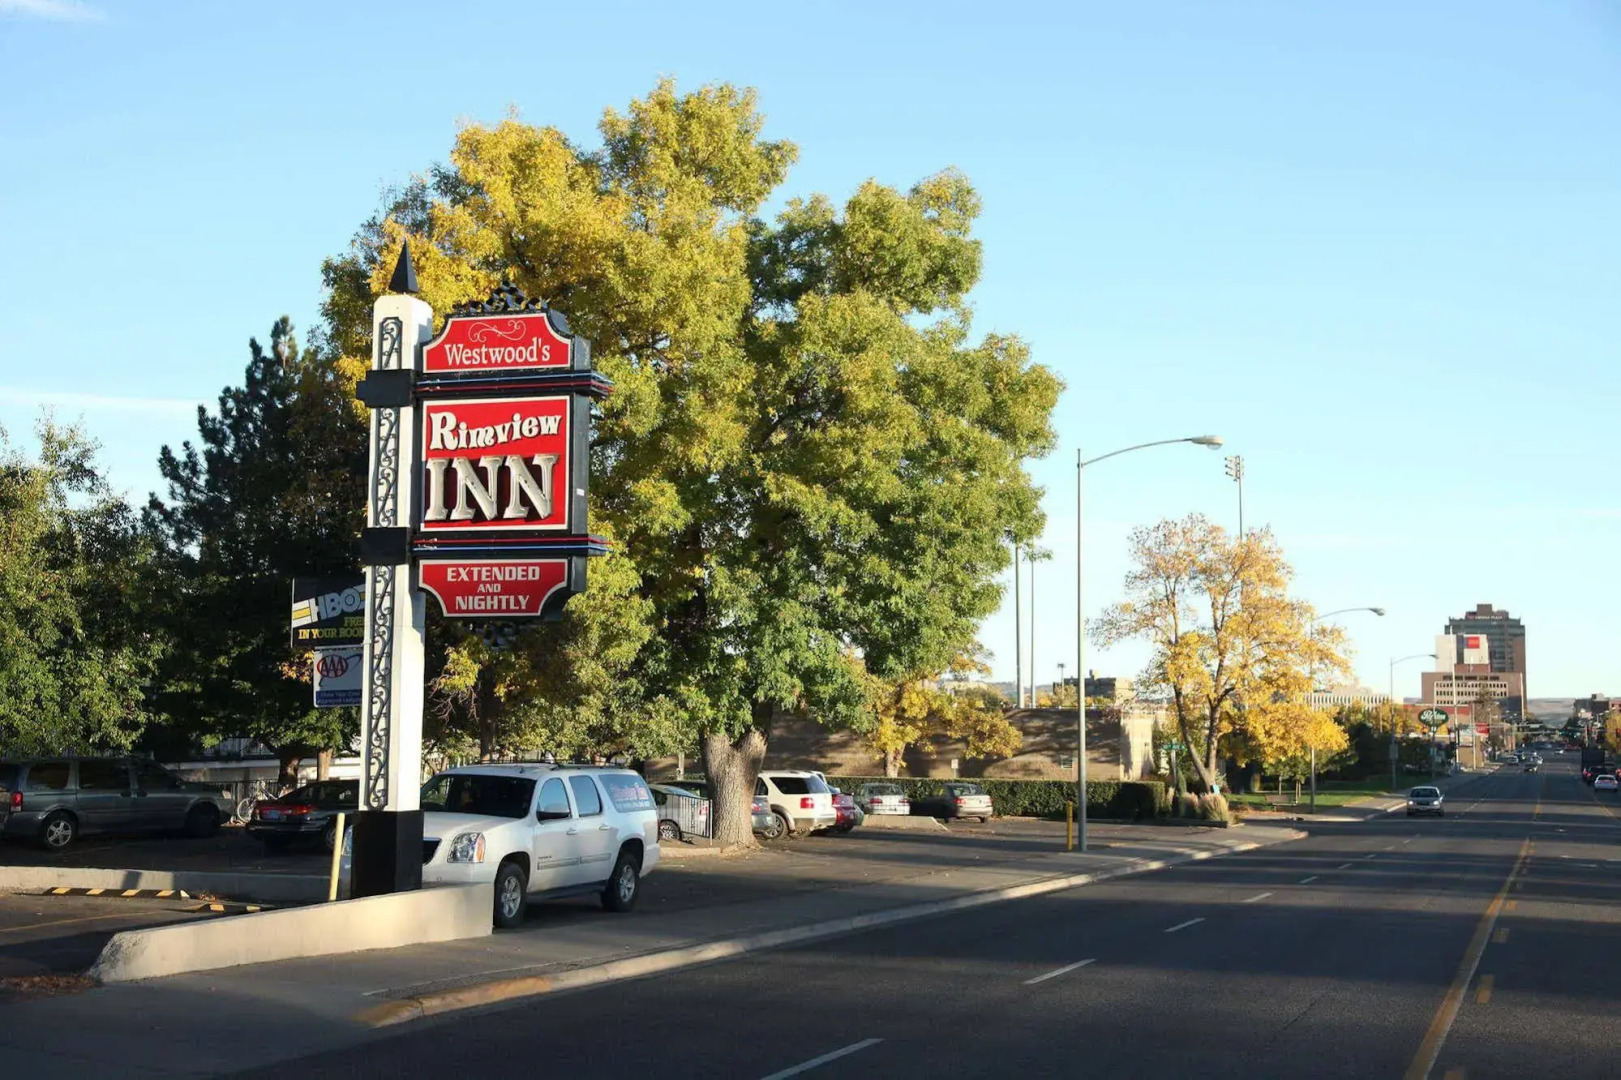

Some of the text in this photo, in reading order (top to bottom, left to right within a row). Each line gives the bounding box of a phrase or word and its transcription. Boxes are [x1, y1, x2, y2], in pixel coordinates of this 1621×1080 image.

[444, 336, 551, 367] Westwood's
[429, 411, 562, 451] Rimview
[424, 453, 560, 522] INN
[447, 566, 541, 583] EXTENDED
[477, 583, 501, 593] AND
[309, 588, 361, 623] HBO
[455, 594, 530, 611] NIGHTLY
[344, 616, 364, 627] FRE
[298, 629, 310, 640] IN
[311, 628, 337, 639] YOUR
[320, 657, 346, 677] AAA
